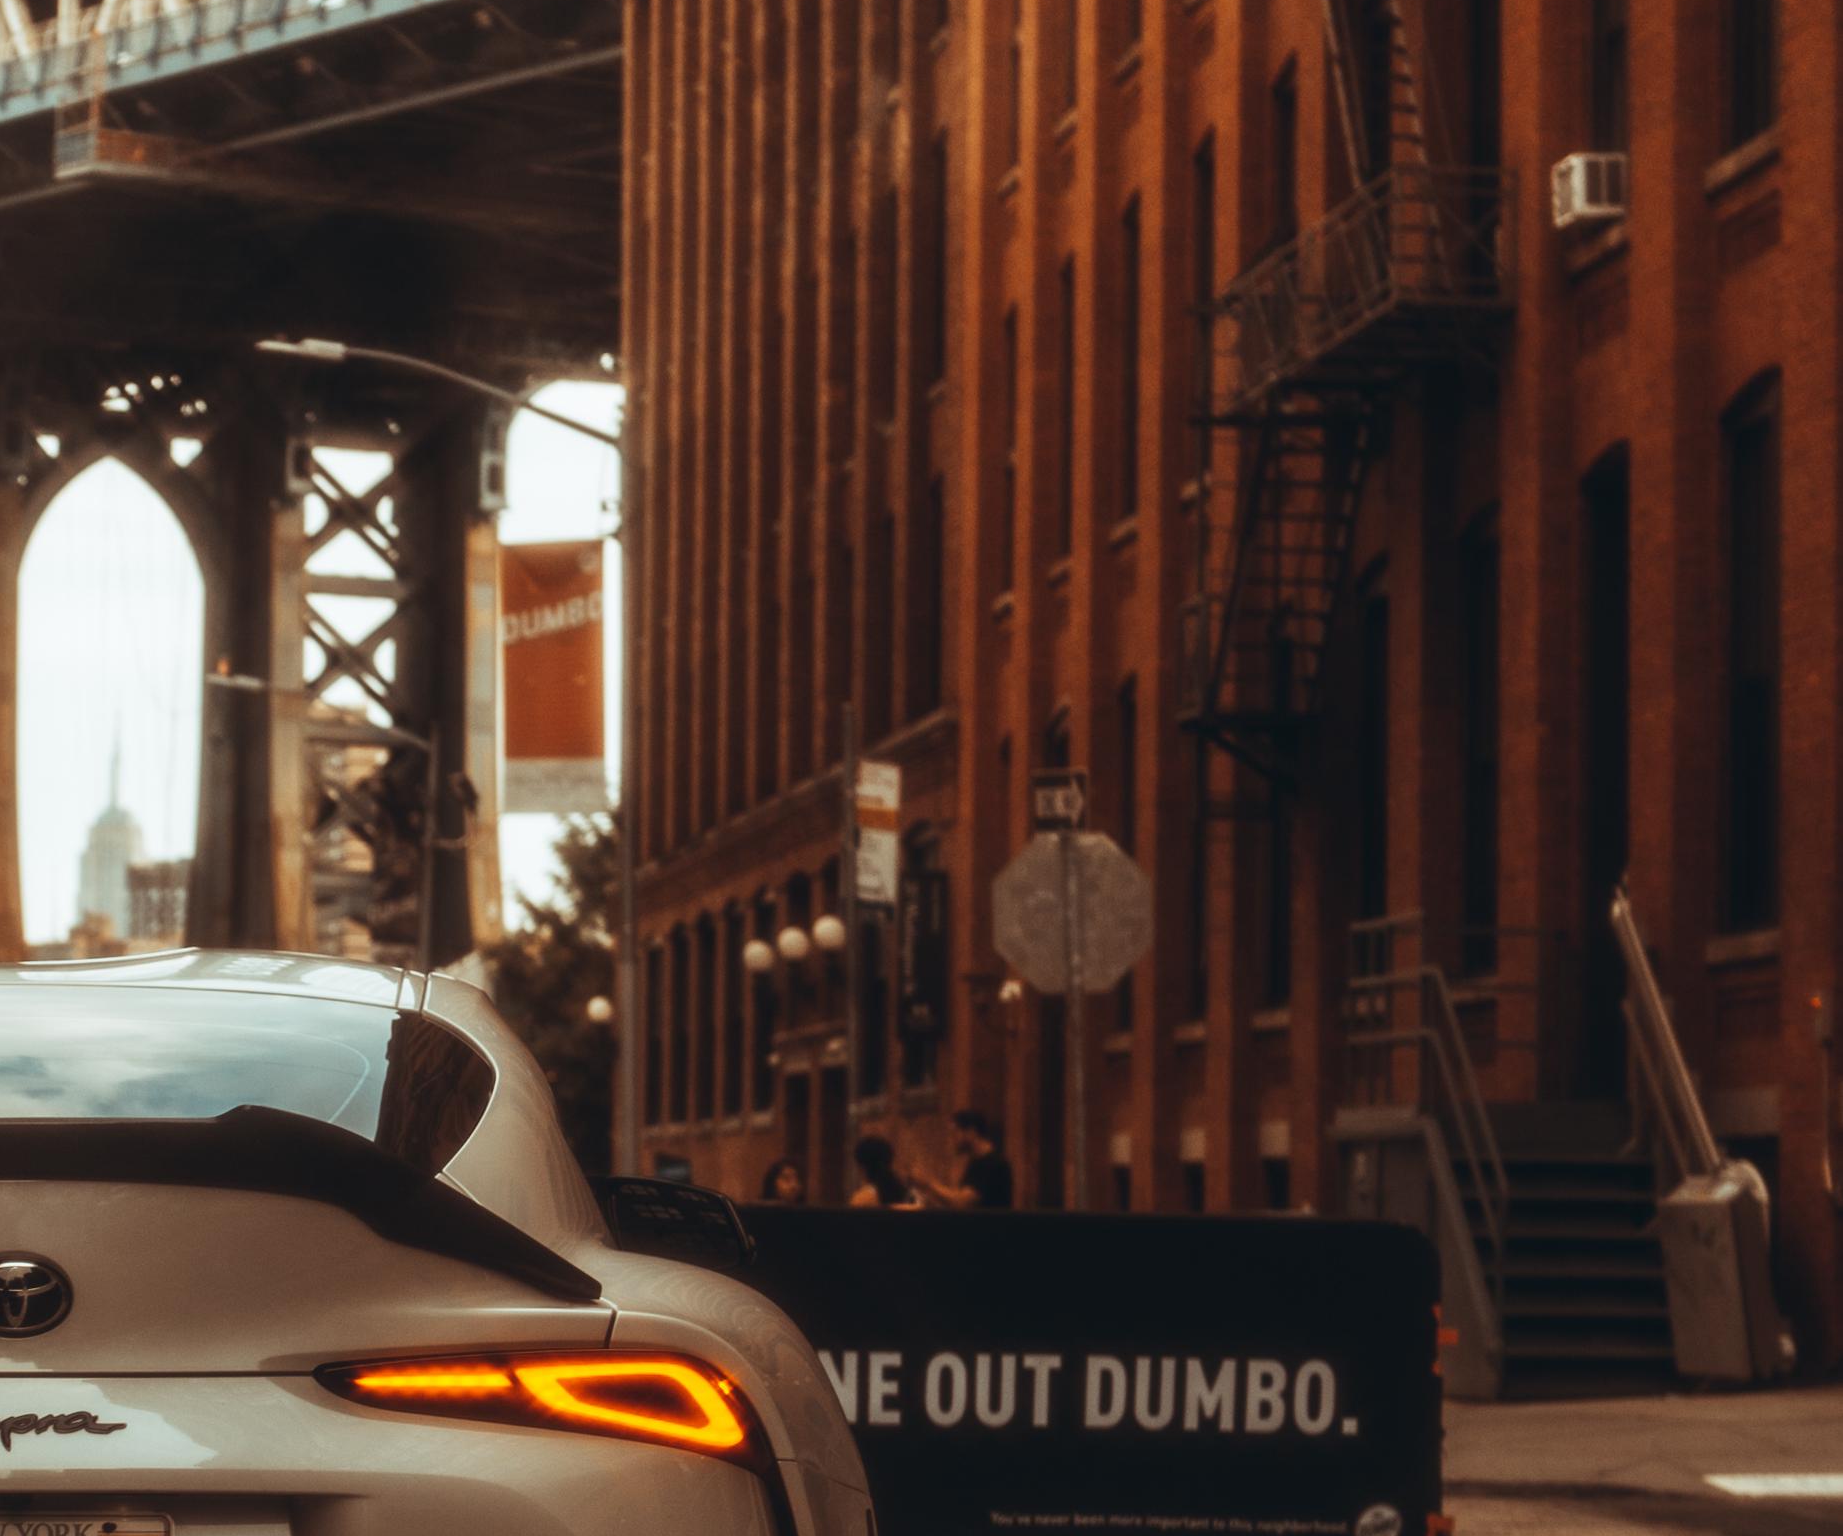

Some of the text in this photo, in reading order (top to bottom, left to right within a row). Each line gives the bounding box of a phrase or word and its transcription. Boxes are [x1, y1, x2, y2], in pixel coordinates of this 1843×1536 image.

[817, 1350, 1359, 1435] NE OUT DUMBO.
[1033, 1513, 1069, 1527] never
[1072, 1512, 1105, 1527] been
[1109, 1513, 1143, 1528] more
[1146, 1514, 1209, 1532] important
